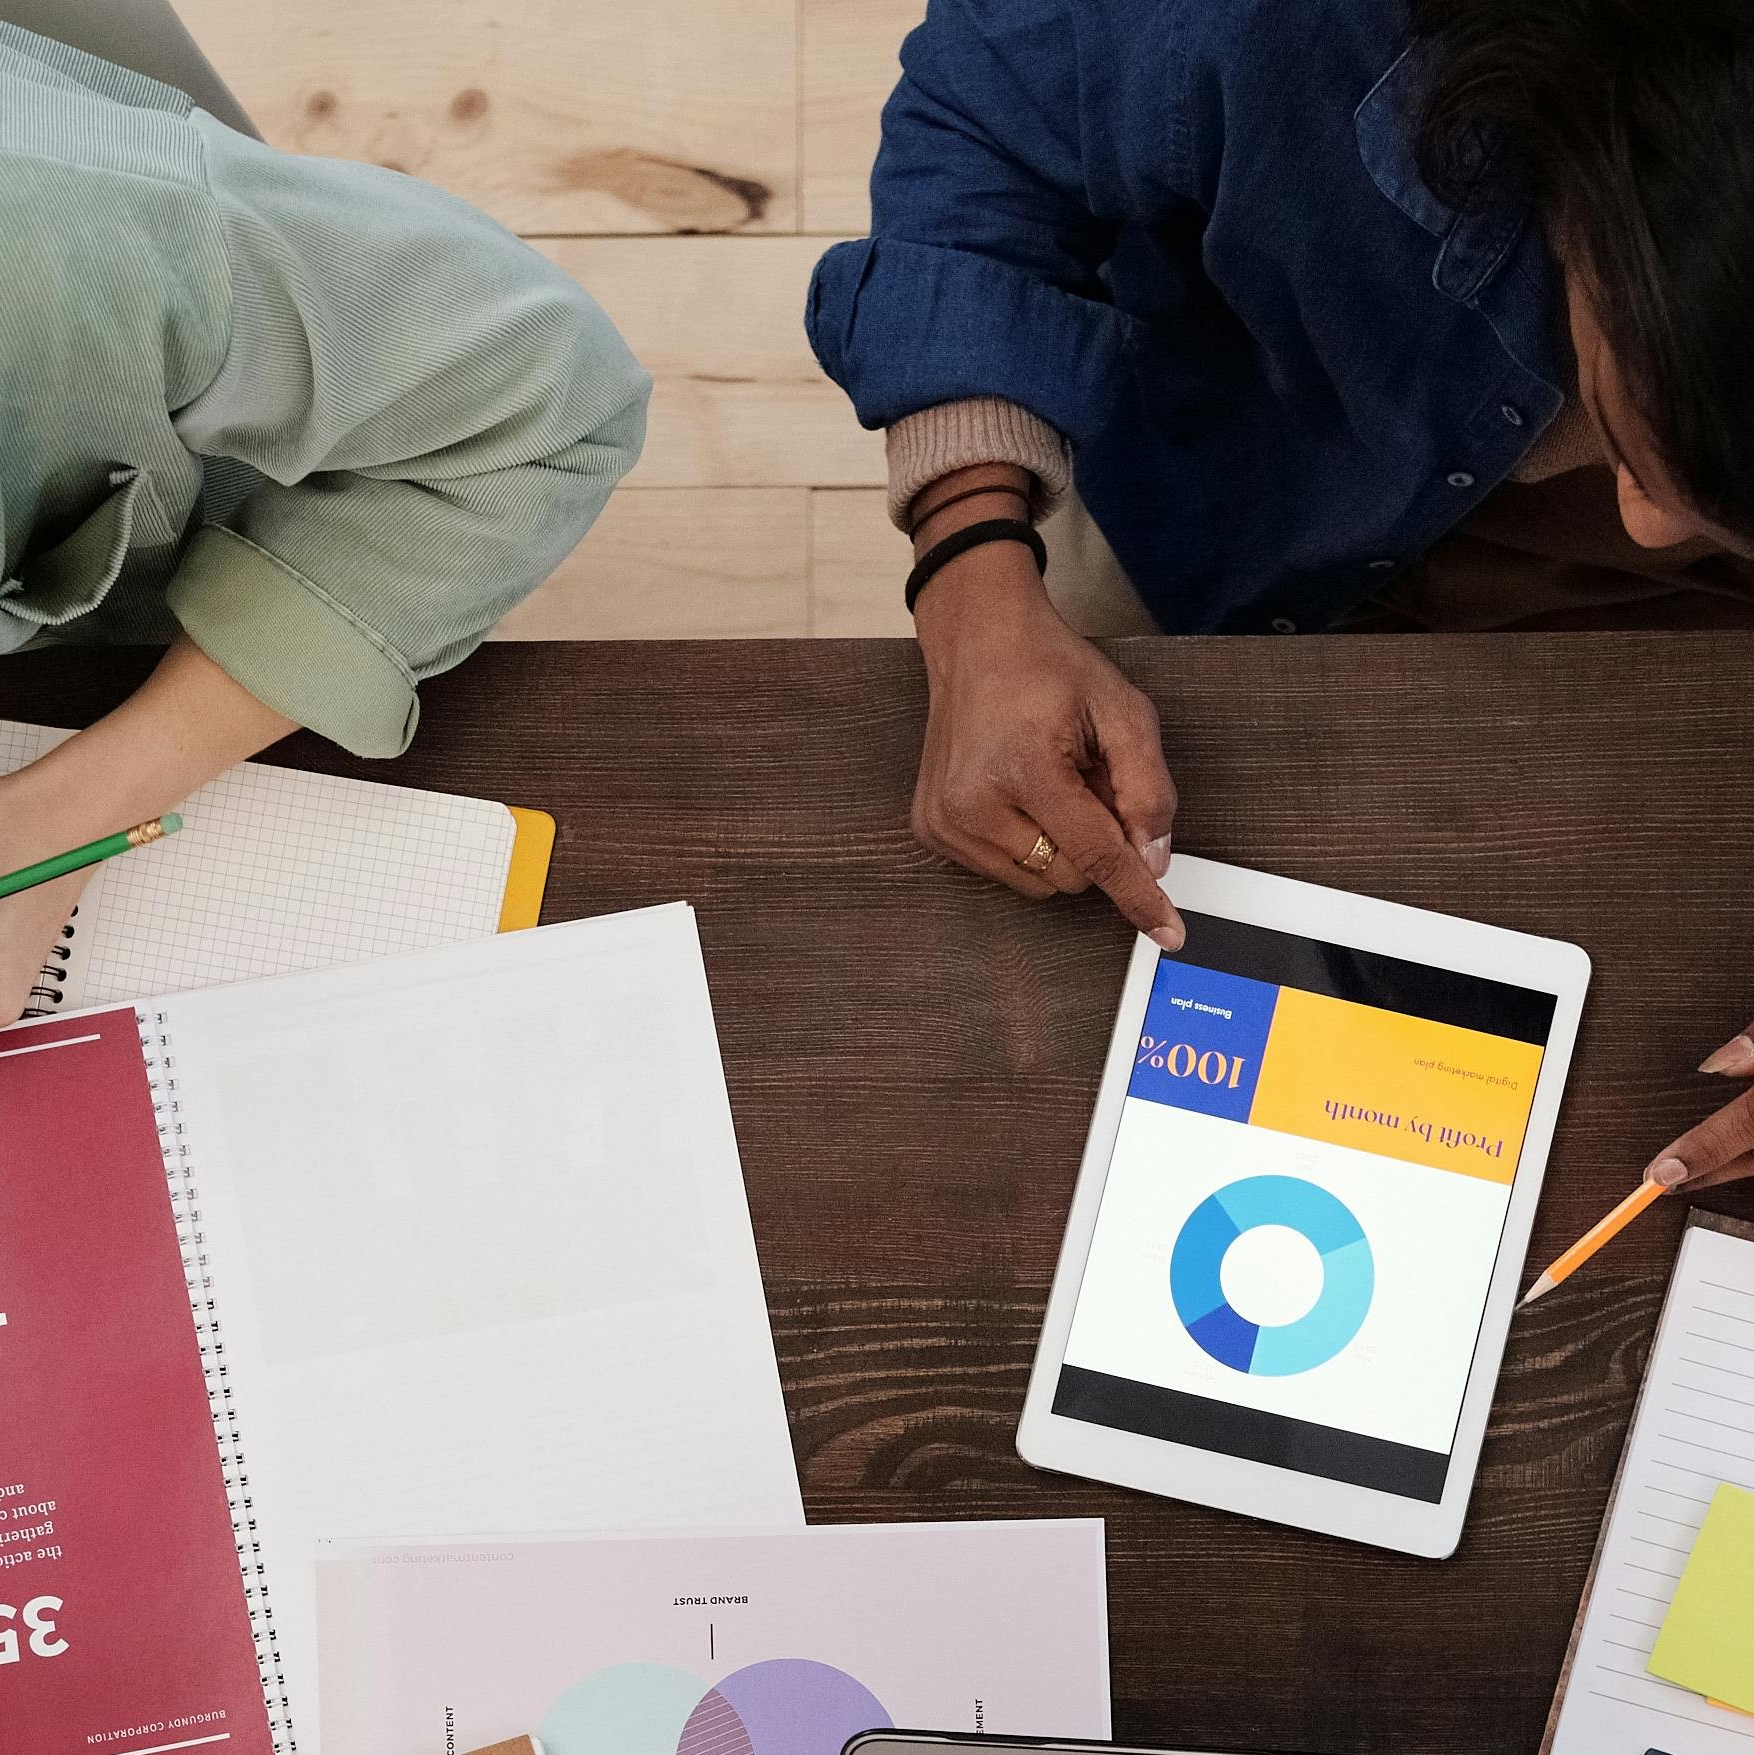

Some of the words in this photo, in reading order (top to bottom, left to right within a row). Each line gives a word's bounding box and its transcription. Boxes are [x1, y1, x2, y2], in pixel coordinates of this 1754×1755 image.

[1171, 998, 1193, 1010] plan
[1195, 1003, 1232, 1019] Business
[1137, 1035, 1245, 1089] 100%
[1414, 1058, 1435, 1070] plan
[1437, 1062, 1484, 1080] marketing
[1486, 1076, 1518, 1091] Digital
[1325, 1101, 1399, 1128] month
[1404, 1116, 1433, 1142] by
[1439, 1127, 1503, 1157] Profit
[12, 1501, 56, 1519] about
[37, 1546, 62, 1560] the
[372, 1550, 514, 1566] contentmarketing.com
[673, 1597, 707, 1605] TRUST
[710, 1596, 748, 1604] BRAND
[169, 1710, 226, 1728] BURGUNDY
[87, 1722, 164, 1743] CORPORATION
